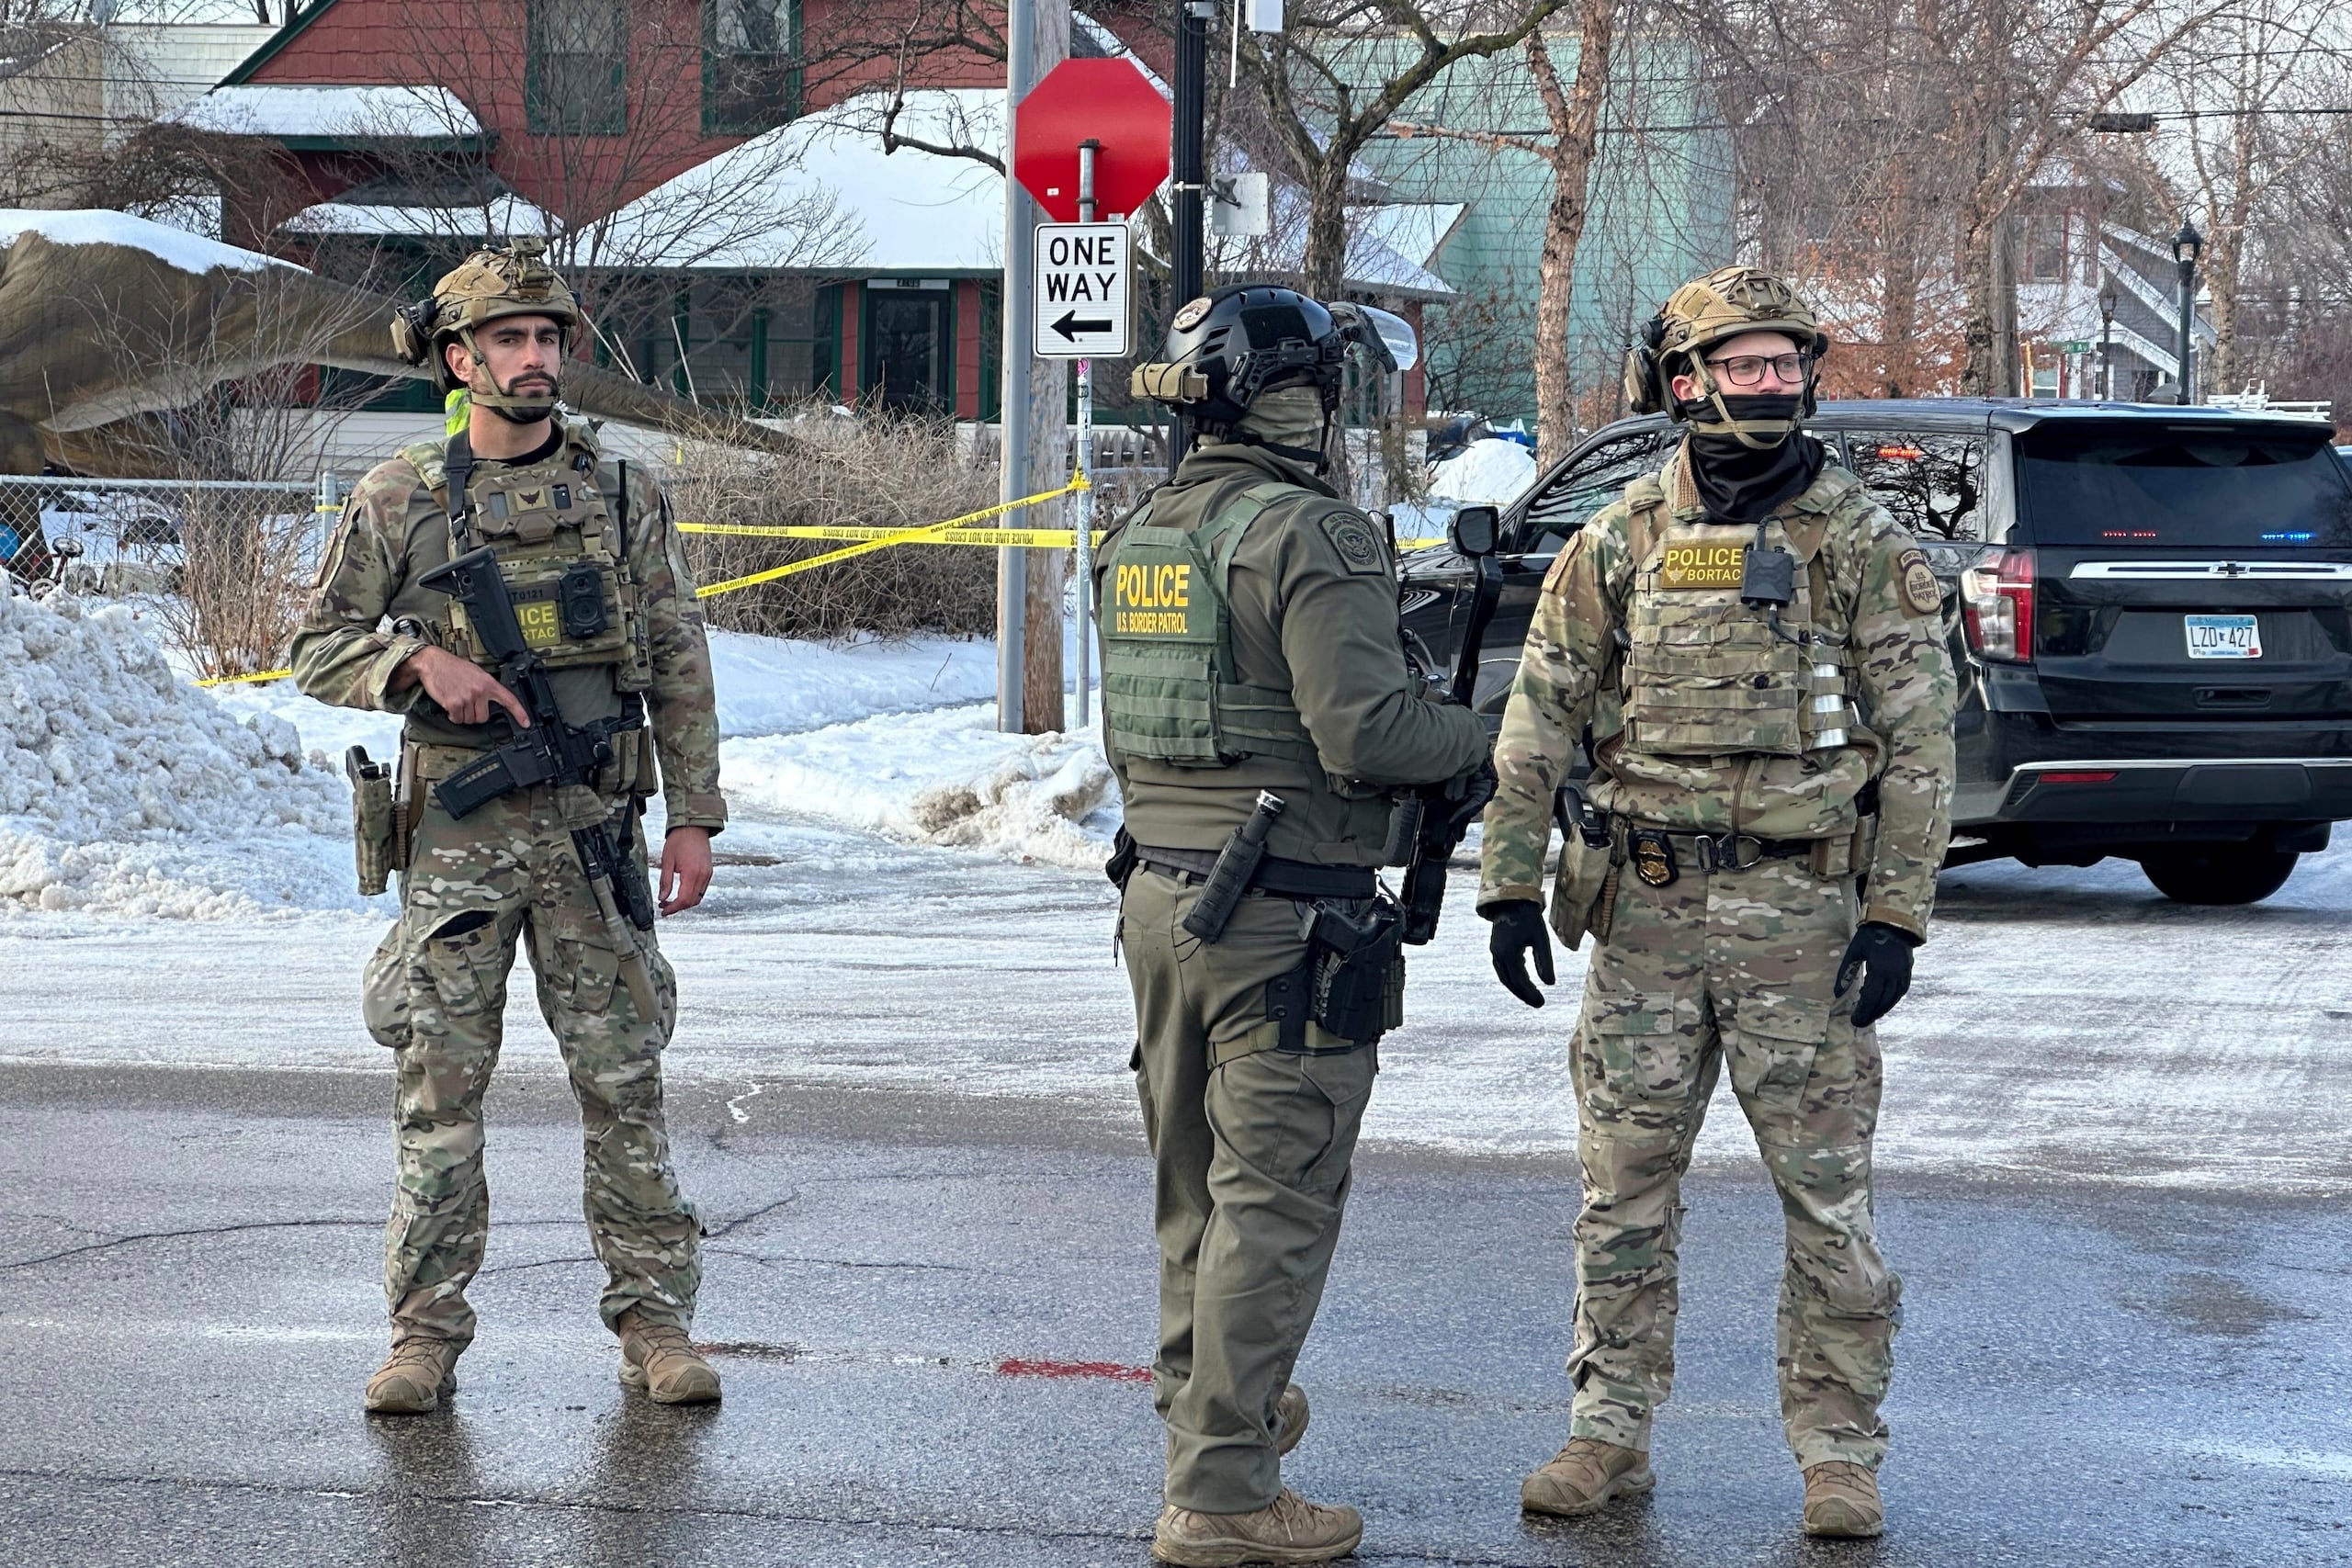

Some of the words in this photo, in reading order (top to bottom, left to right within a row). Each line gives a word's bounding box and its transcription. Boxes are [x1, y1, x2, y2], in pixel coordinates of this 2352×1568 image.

[1049, 236, 1115, 265] ONE
[1046, 272, 1117, 301] WAY
[944, 531, 967, 542] CROSS
[968, 531, 982, 543] NOT
[984, 532, 994, 544] DO
[995, 532, 1010, 545] LINE
[1011, 533, 1035, 545] POLICE
[1667, 547, 1744, 568] POLICE
[1687, 569, 1741, 581] BORTAC
[1116, 564, 1191, 607] POLICE
[1911, 590, 1939, 604] PATROL
[519, 605, 555, 626] ICE
[1116, 612, 1128, 633] U.S.
[1129, 612, 1158, 633] BORDER
[1158, 612, 1188, 634] PATROL
[522, 626, 556, 641] RTAC
[2190, 626, 2218, 648] LZD
[2229, 626, 2253, 648] 427
